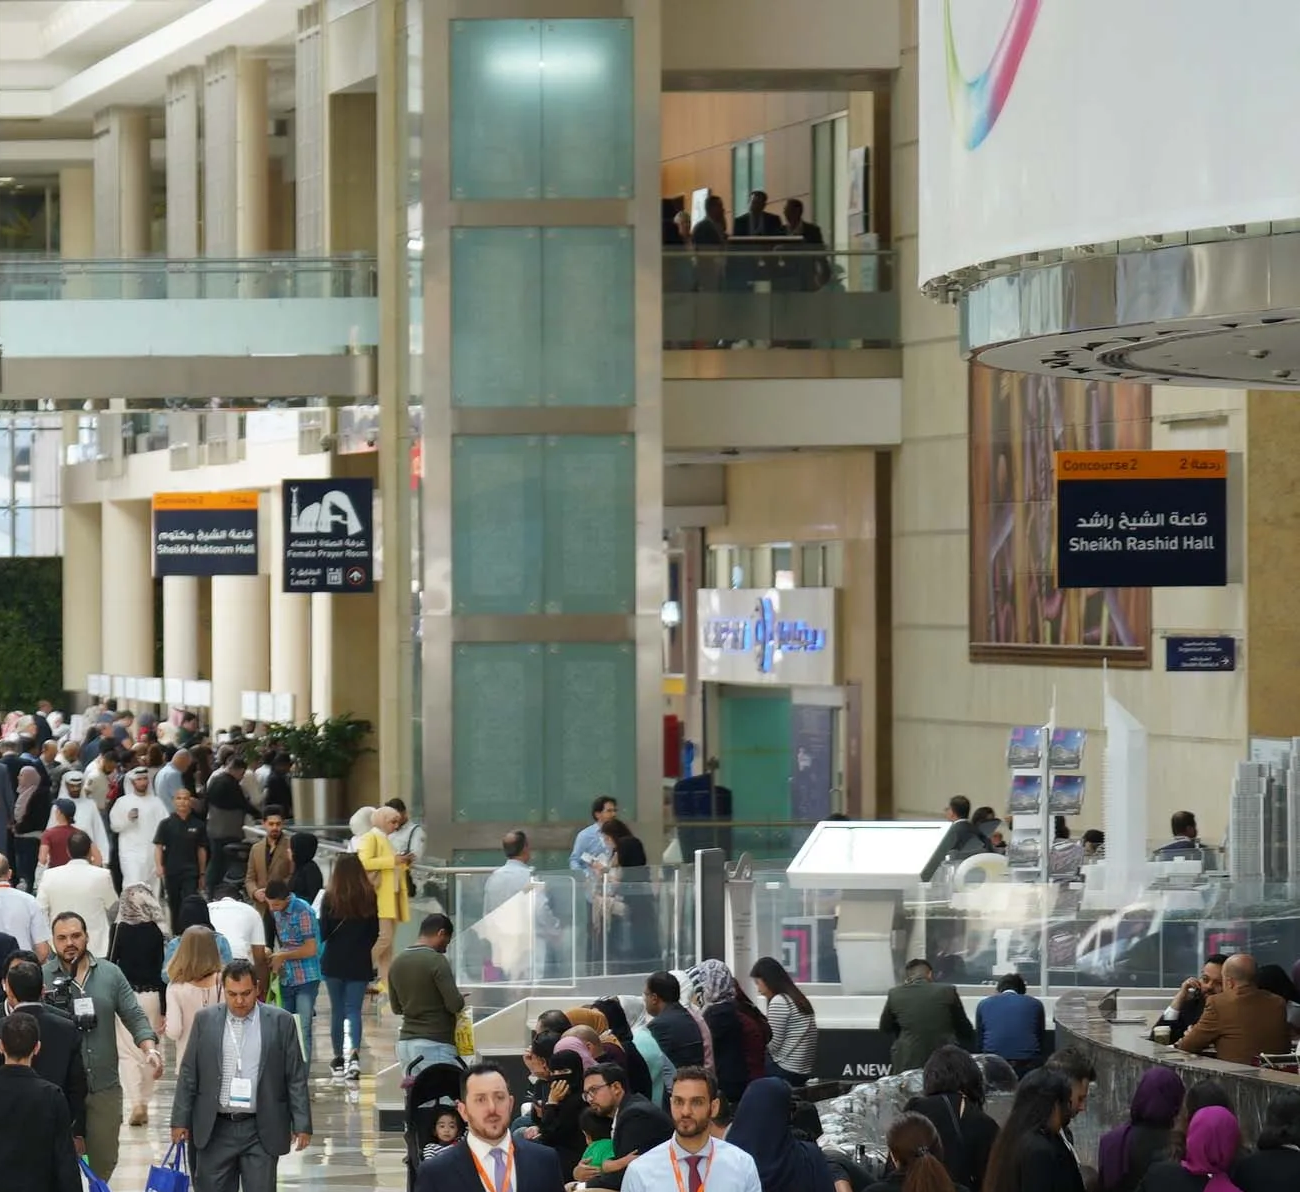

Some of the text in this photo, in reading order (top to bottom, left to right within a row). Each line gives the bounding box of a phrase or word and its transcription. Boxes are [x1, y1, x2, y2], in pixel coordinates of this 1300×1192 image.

[1062, 458, 1138, 471] Concourse 2
[1191, 460, 1221, 471] ردهة
[1076, 510, 1208, 530] قاعة الشيخ راشد
[158, 528, 254, 541] قاعة الشيخ مكتوم
[156, 543, 255, 555] Sheikh Maktoum Hall
[1068, 535, 1215, 551] Sheikh Rashid Hall
[287, 550, 368, 560] Female Prayer Room
[290, 578, 309, 586] Level
[842, 1063, 892, 1076] A NEW
